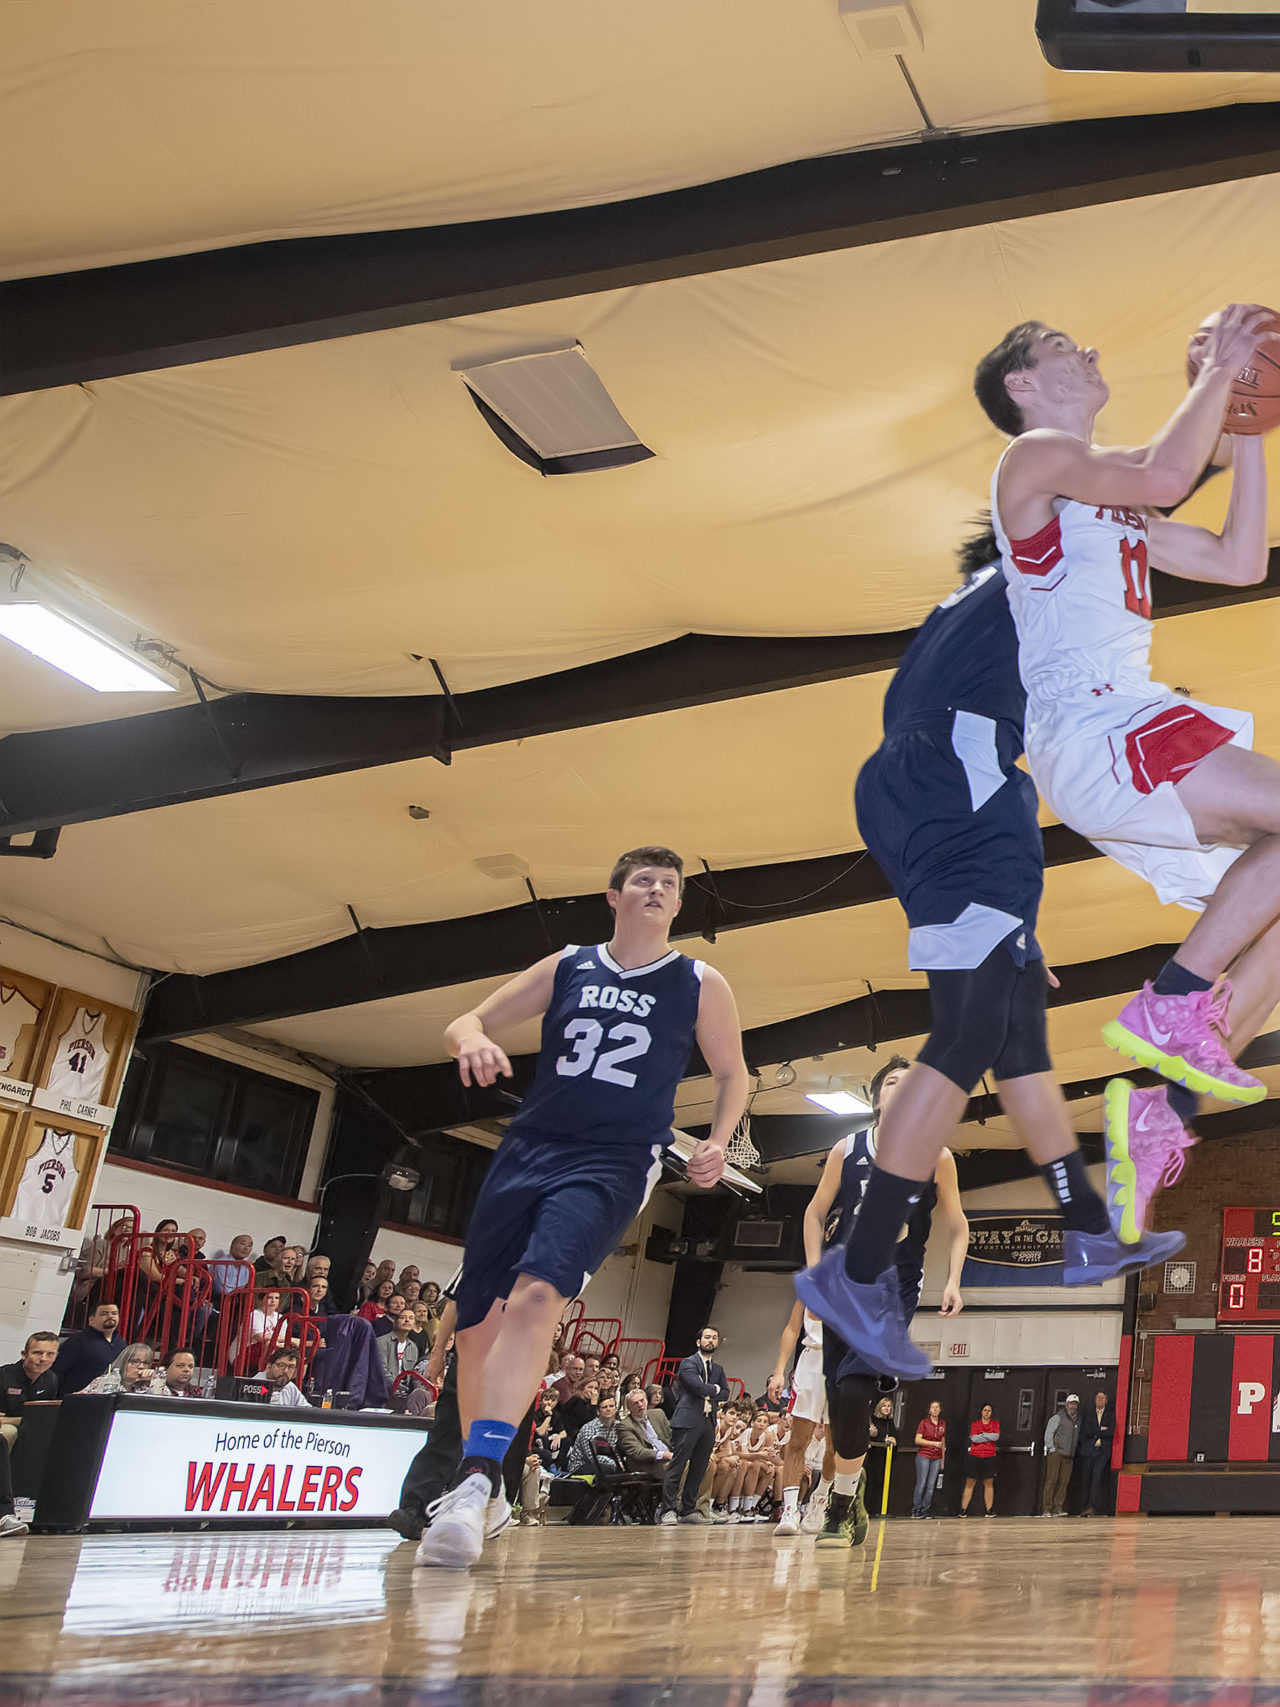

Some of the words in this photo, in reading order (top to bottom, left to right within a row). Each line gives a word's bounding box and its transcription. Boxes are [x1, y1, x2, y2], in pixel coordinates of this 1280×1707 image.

[578, 985, 657, 1018] ROSS
[68, 1052, 87, 1074] 41
[556, 1018, 652, 1088] 32
[41, 1174, 56, 1194] 5
[968, 1230, 1015, 1244] STAY
[1023, 1234, 1033, 1243] THE
[1036, 1230, 1065, 1243] GA
[1248, 1249, 1262, 1272] 8
[1229, 1284, 1244, 1308] 0
[953, 1344, 967, 1354] EXIT
[243, 1385, 261, 1394] POSS
[1237, 1382, 1265, 1414] P
[215, 1432, 259, 1452] Home
[263, 1429, 281, 1447] of
[281, 1431, 303, 1449] the
[306, 1432, 350, 1457] Pierson
[185, 1461, 363, 1512] WHALERS
